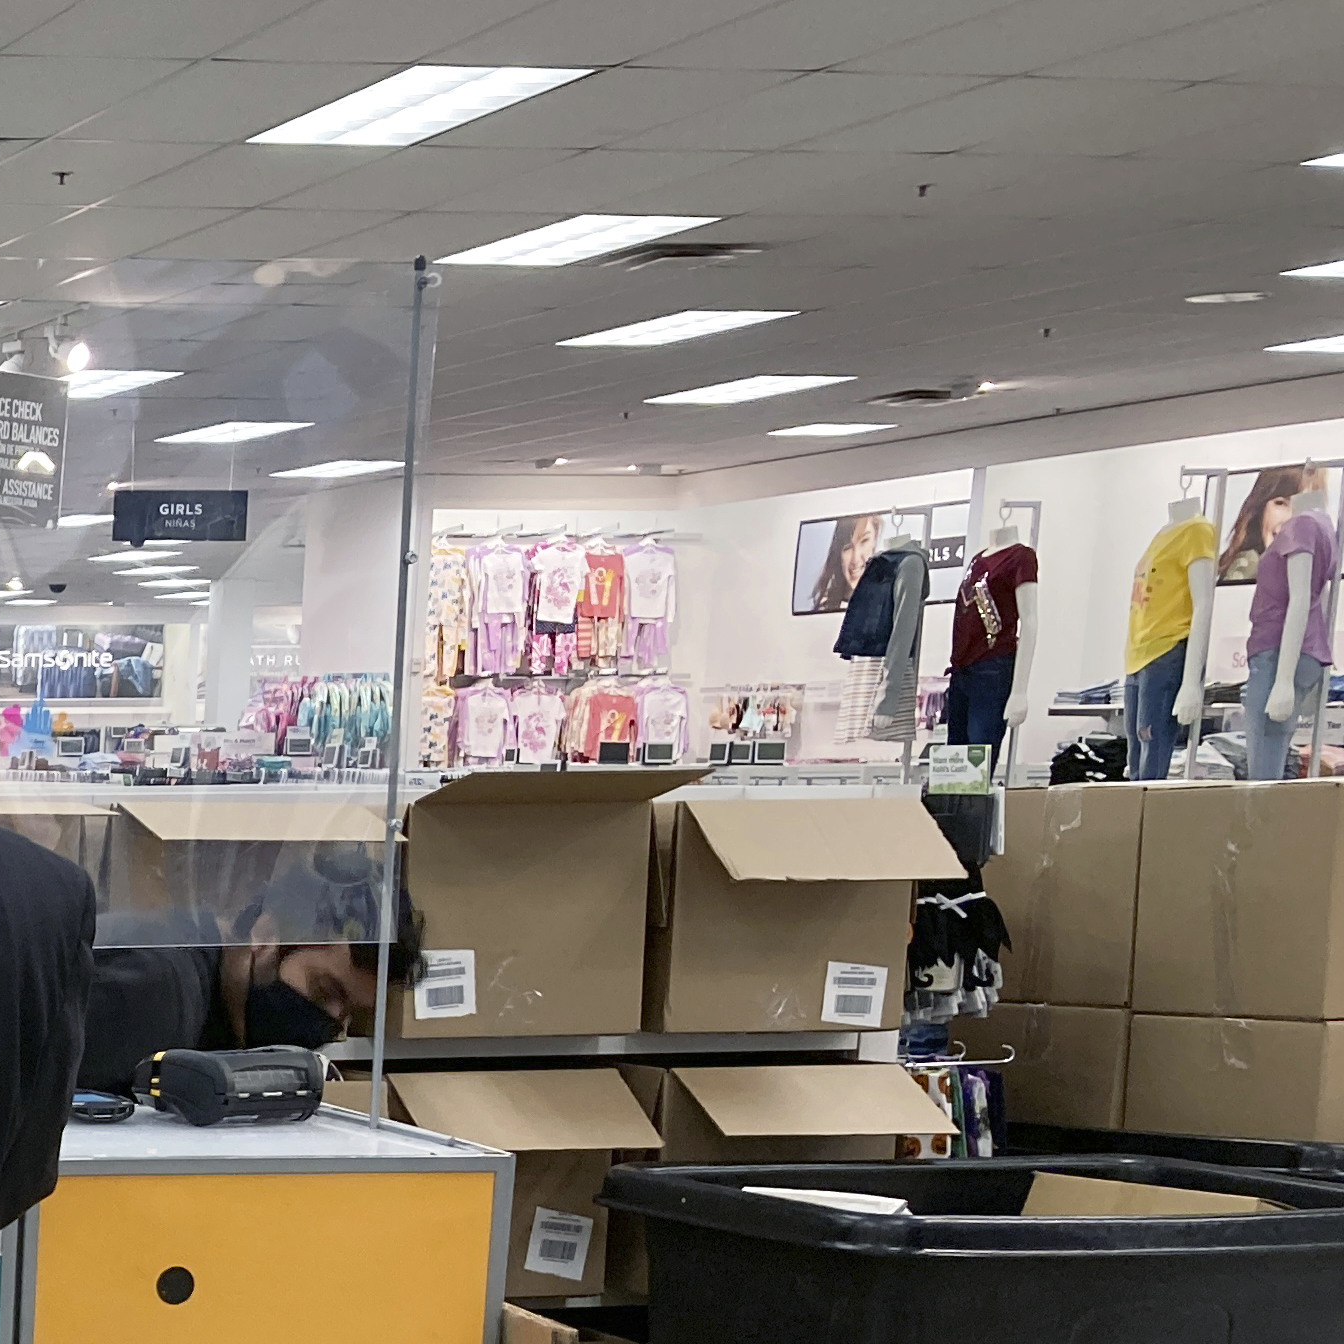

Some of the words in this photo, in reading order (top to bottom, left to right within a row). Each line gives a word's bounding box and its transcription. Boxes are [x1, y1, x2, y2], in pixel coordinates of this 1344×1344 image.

[12, 400, 43, 422] CHECK
[11, 422, 60, 447] BALANCES
[2, 478, 54, 500] ASSISTANCE
[159, 503, 203, 515] GIRLS
[165, 518, 196, 528] NIÑAS
